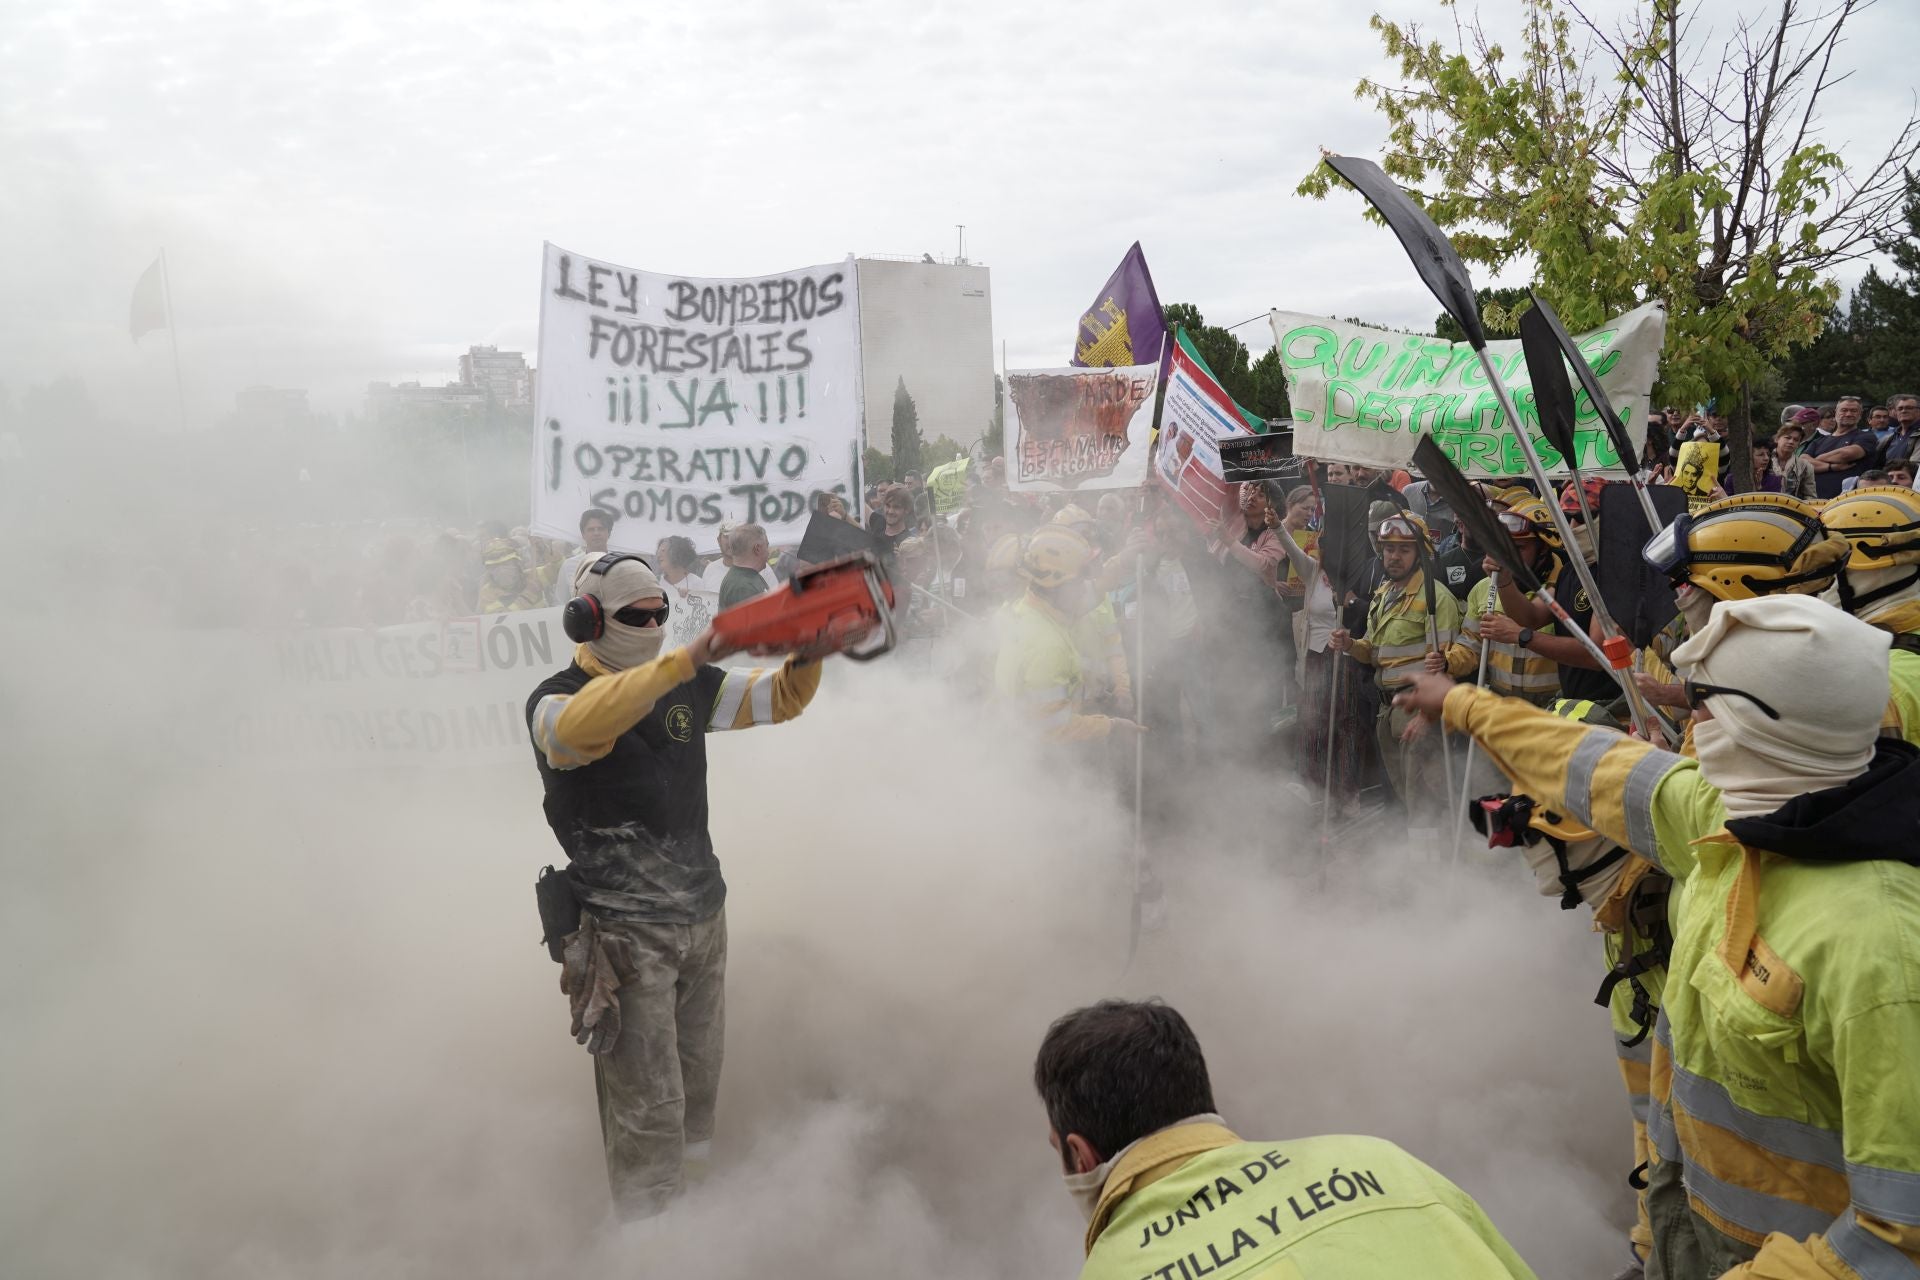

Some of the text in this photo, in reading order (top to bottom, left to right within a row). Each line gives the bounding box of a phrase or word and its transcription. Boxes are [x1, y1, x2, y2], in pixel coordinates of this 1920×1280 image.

[554, 255, 844, 325] LEY BOMBEROS
[590, 315, 813, 374] FORESTALES
[1085, 379, 1146, 405] ARDE
[1021, 458, 1046, 478] LOS
[591, 489, 722, 524] SOMOS
[1693, 552, 1738, 562] HEADLIGHT
[374, 615, 553, 680] GESIÓN
[1139, 1150, 1290, 1248] JUNTA DE
[1140, 1167, 1386, 1280] TILLA Y LEÓN
